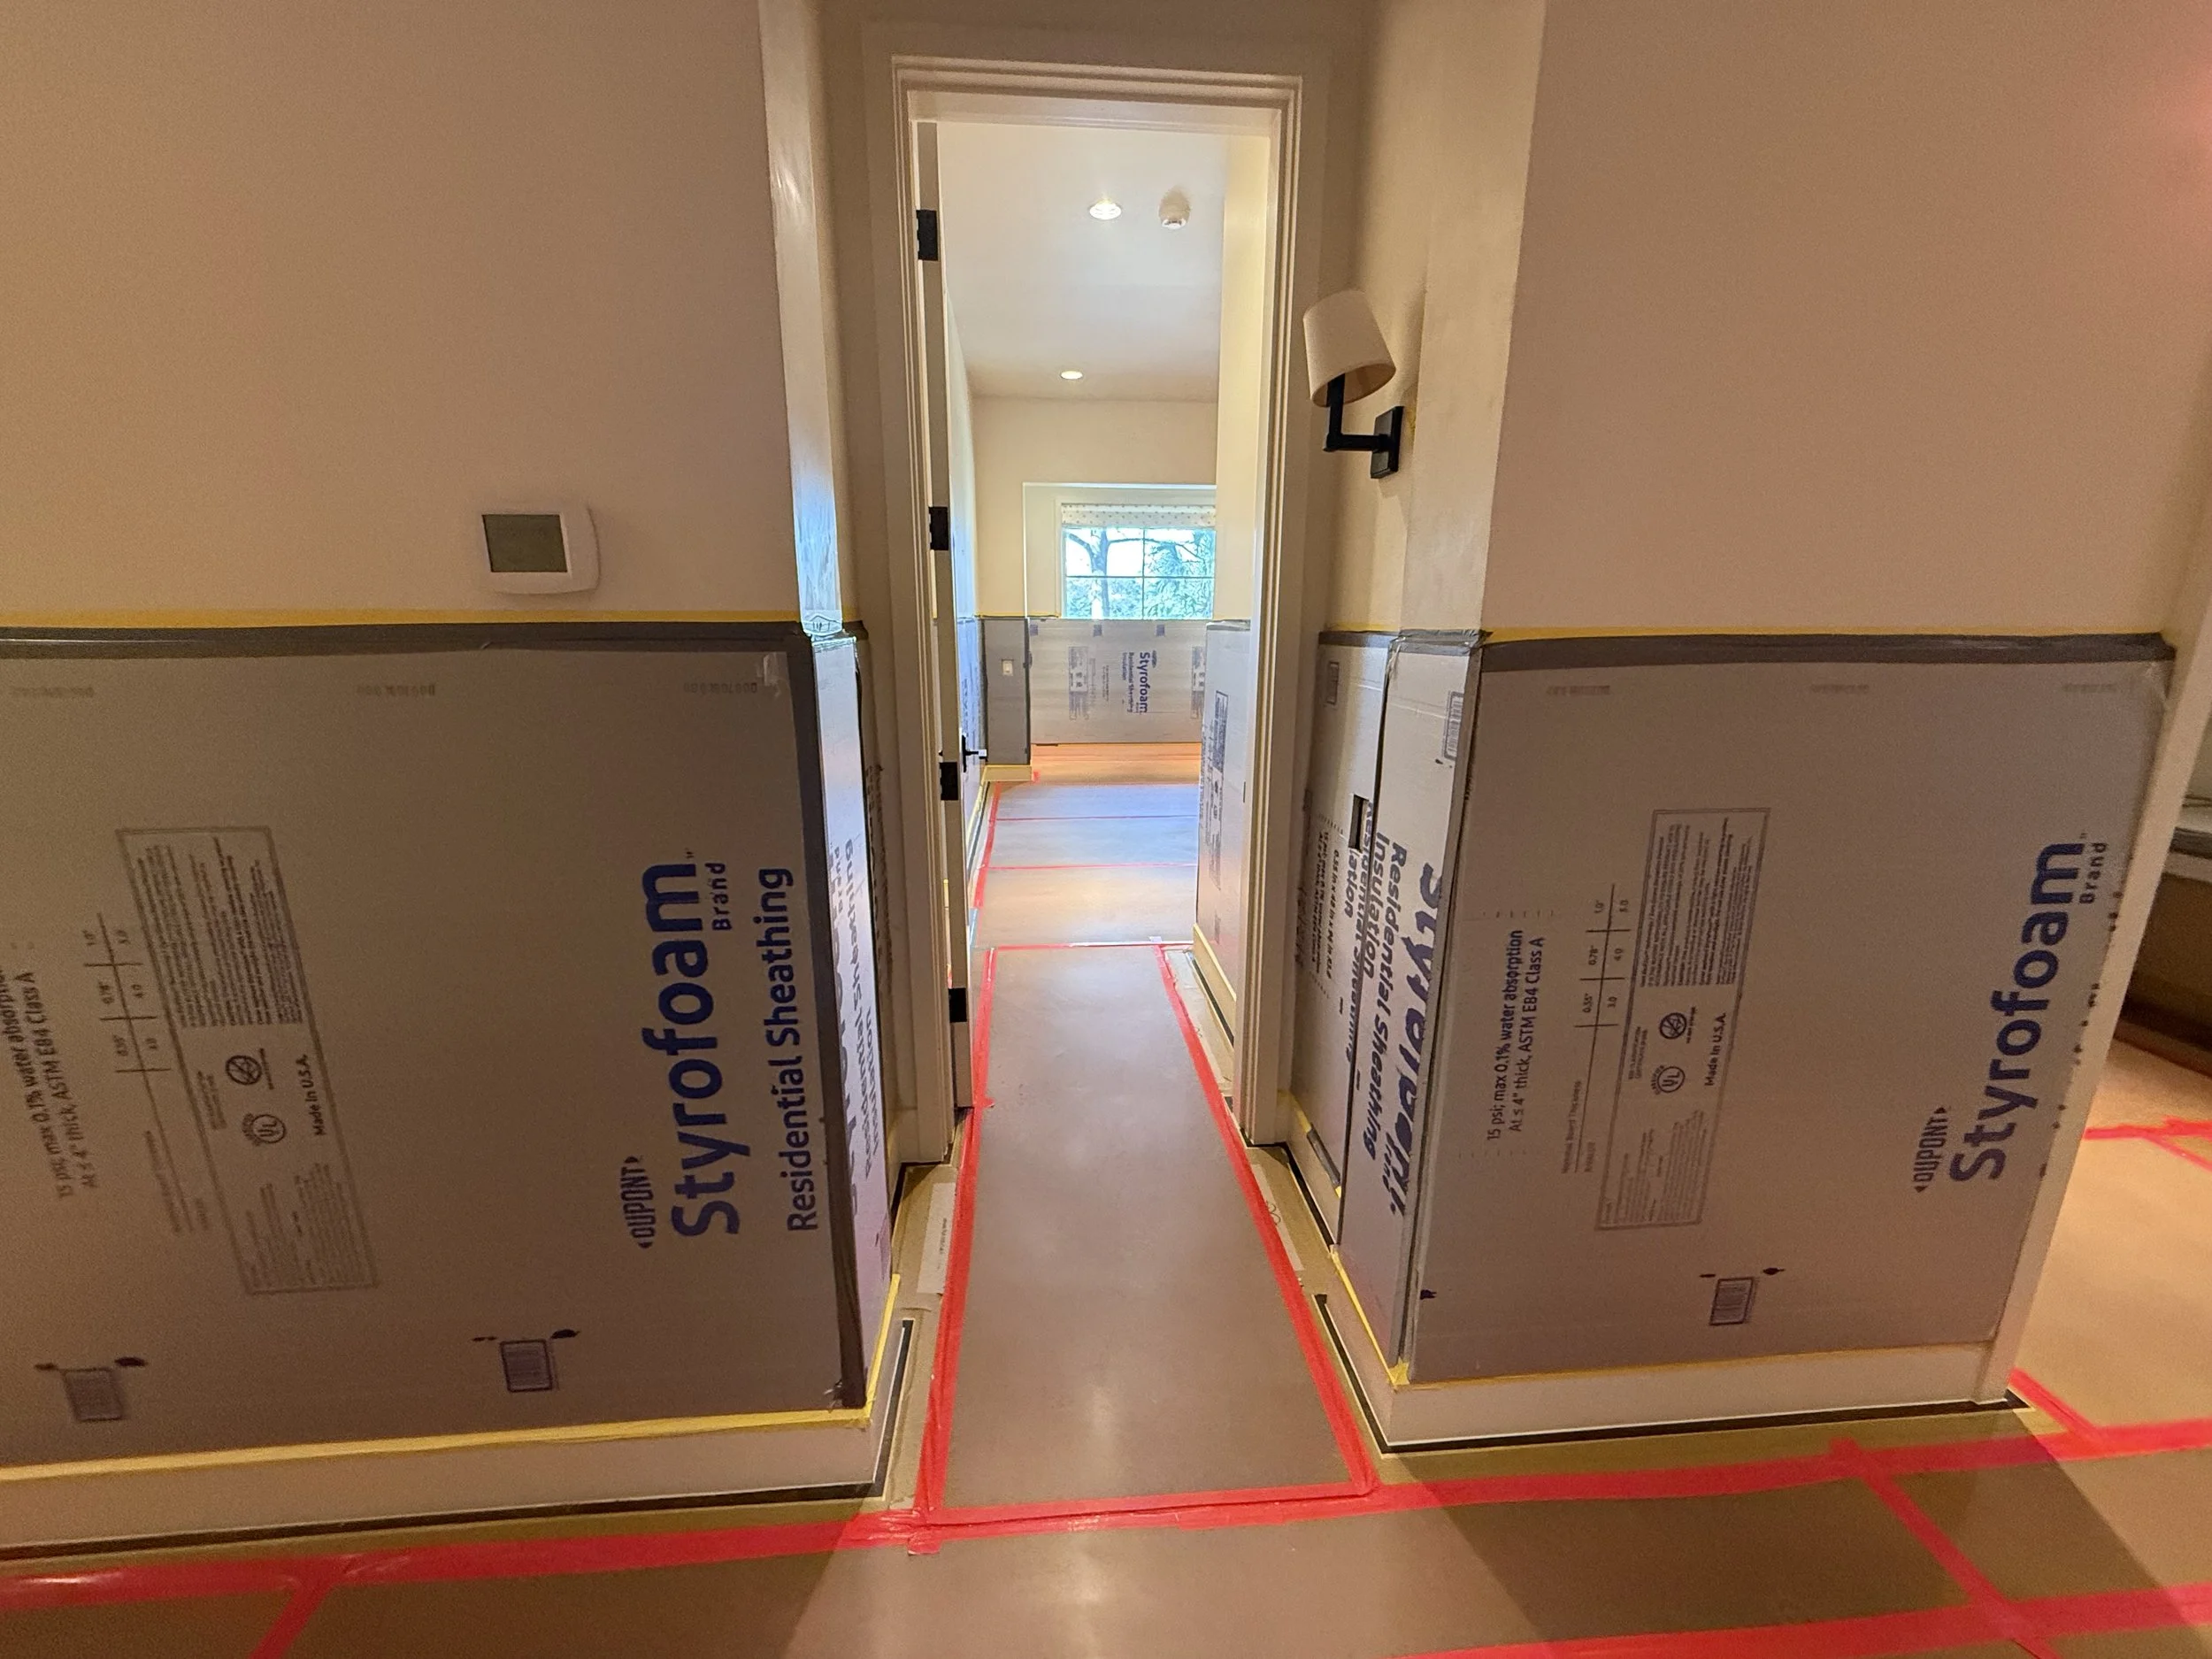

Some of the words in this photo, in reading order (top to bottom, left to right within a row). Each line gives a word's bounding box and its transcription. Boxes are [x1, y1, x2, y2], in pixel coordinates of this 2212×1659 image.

[1137, 651, 1151, 713] Styrofoam
[2079, 841, 2108, 905] Brand
[704, 862, 733, 932] Brand
[1368, 832, 1390, 979] Insulation
[1378, 841, 1407, 1016] Residential
[1532, 937, 1545, 948] A
[13, 972, 35, 984] A
[752, 868, 800, 1046] Sheathing
[1501, 929, 1524, 1001] absorption
[1528, 950, 1543, 984] Class
[19, 986, 48, 1024] Class
[1499, 1004, 1516, 1041] water
[1949, 842, 2085, 1182] Styrofoam
[640, 862, 750, 1236] Styrofoam
[1521, 1016, 1537, 1052] ASTM
[1704, 1056, 1718, 1087] Made
[1712, 1012, 1726, 1042] U.S.A.
[10, 1045, 39, 1087] water
[1494, 1043, 1511, 1072] 0.1%
[1514, 1055, 1532, 1089] thick,
[43, 1059, 72, 1100] ASTM
[1363, 1014, 1388, 1161] Sheathing
[1494, 1075, 1508, 1102] max
[1663, 1071, 1680, 1087] UL
[39, 1125, 62, 1156] max
[310, 1104, 326, 1136] Made
[1486, 1128, 1502, 1141] 15
[768, 1056, 818, 1231] Residential
[1913, 1116, 1948, 1183] DUPONT
[620, 1166, 656, 1239] DUPONT
